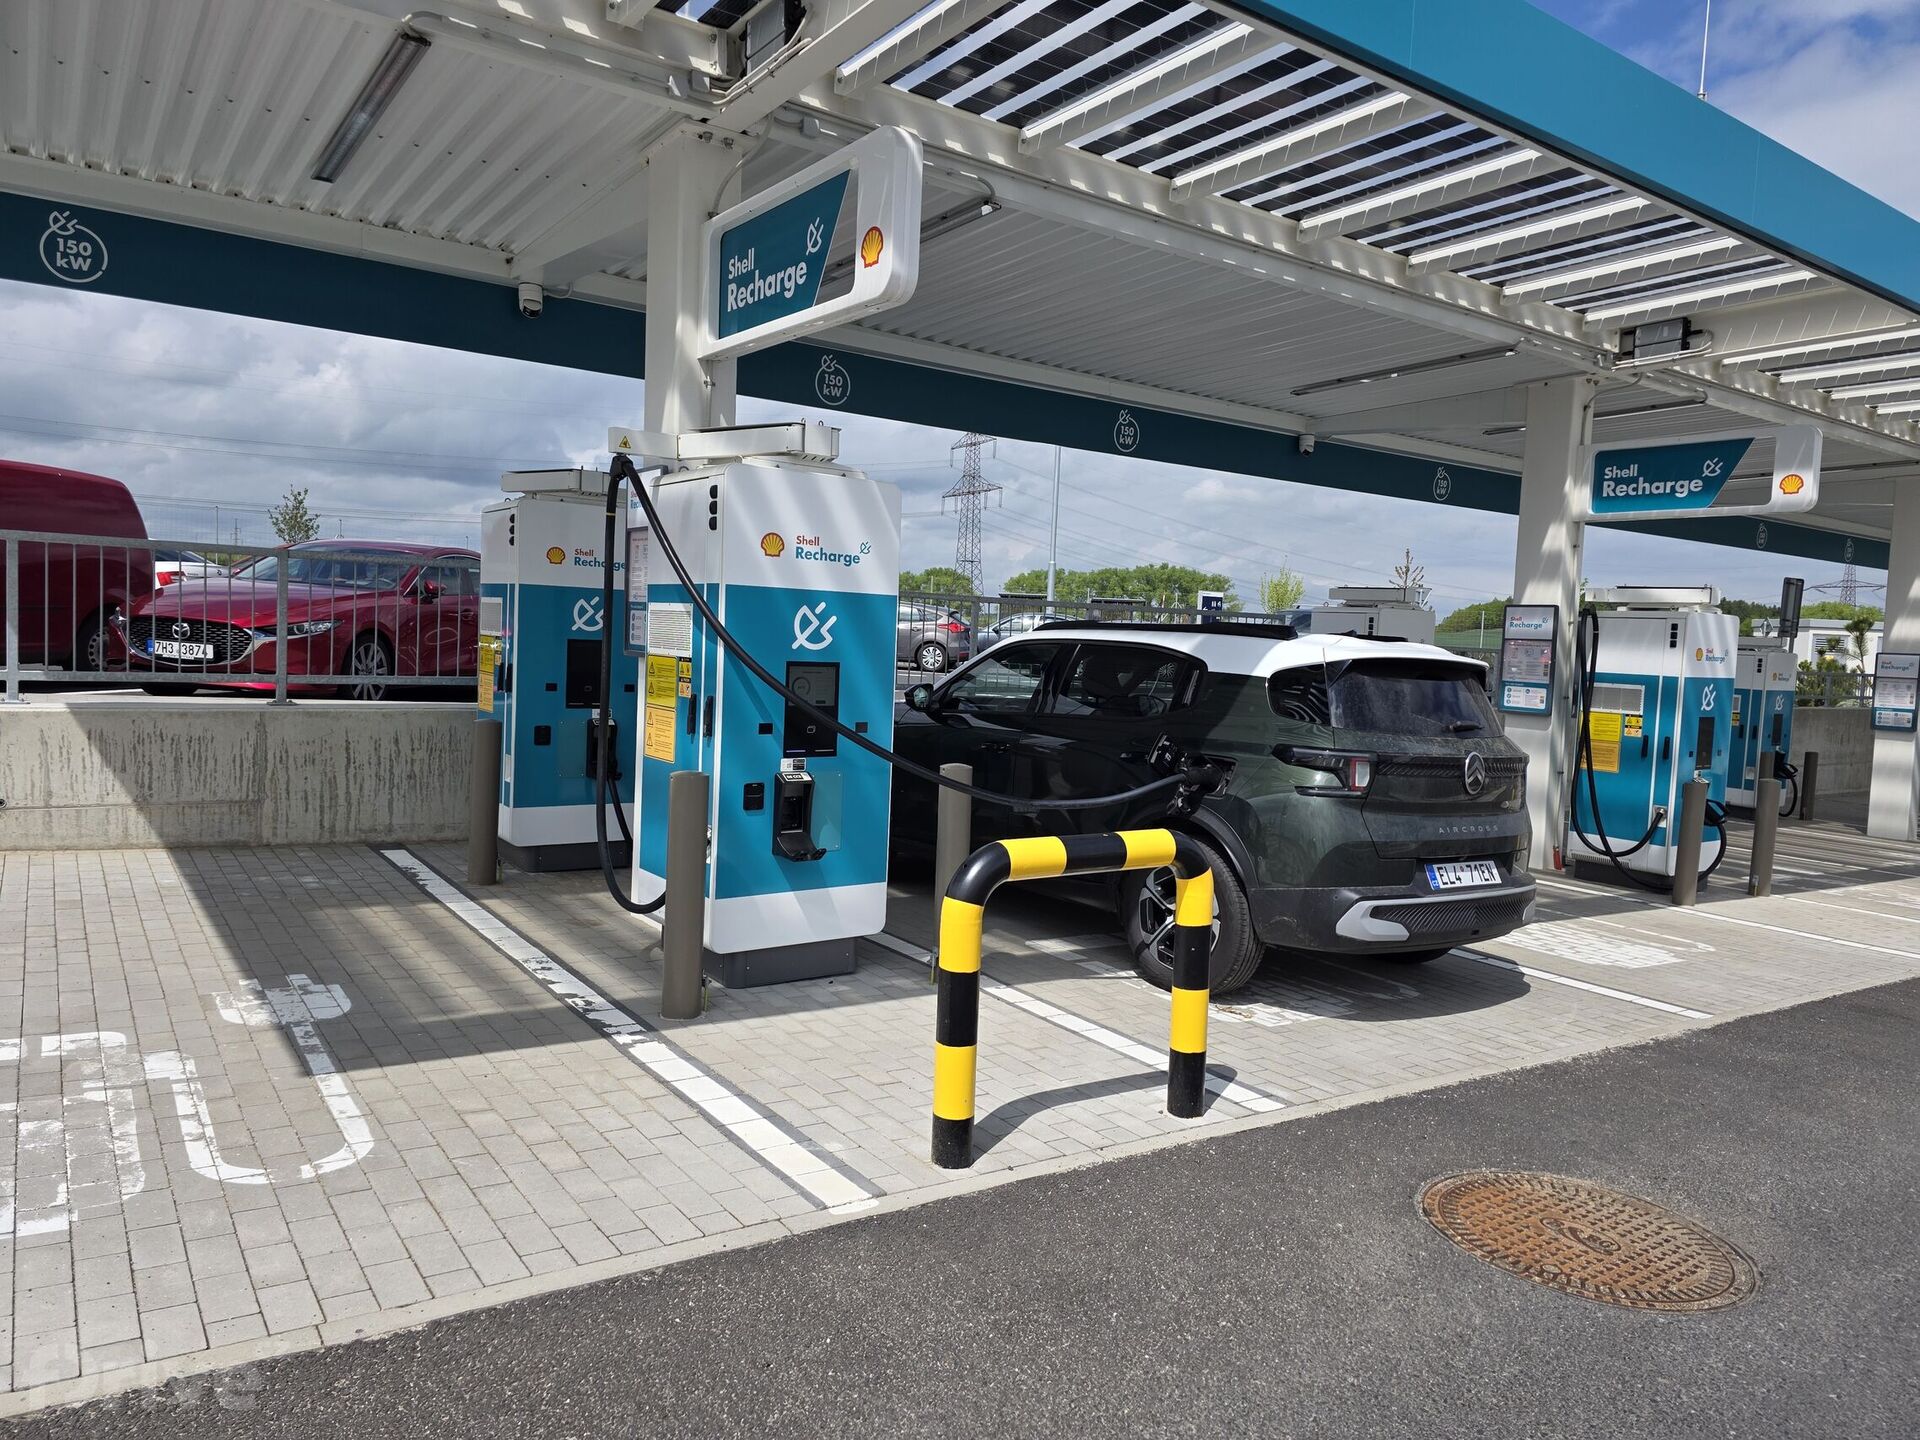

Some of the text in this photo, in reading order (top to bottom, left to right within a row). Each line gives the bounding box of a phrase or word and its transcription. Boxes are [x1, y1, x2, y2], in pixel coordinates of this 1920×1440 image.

[57, 237, 92, 257] 150
[56, 251, 92, 272] kW
[728, 247, 755, 280] Shell
[727, 261, 808, 312] Recharge
[824, 373, 843, 387] 150
[823, 383, 842, 398] kW
[1120, 425, 1135, 436] 150
[1119, 433, 1134, 445] kW
[1604, 463, 1638, 479] Shell
[1602, 476, 1703, 498] Recharge
[796, 535, 820, 546] Shell
[574, 548, 594, 557] Shell
[795, 546, 861, 567] Recharge
[574, 556, 626, 571] Rechge
[1509, 621, 1543, 630] Recharge
[155, 641, 174, 654] 7H3
[1438, 824, 1499, 834] AIRCROSS
[1436, 865, 1463, 886] EL4
[1465, 863, 1497, 883] 71EN
